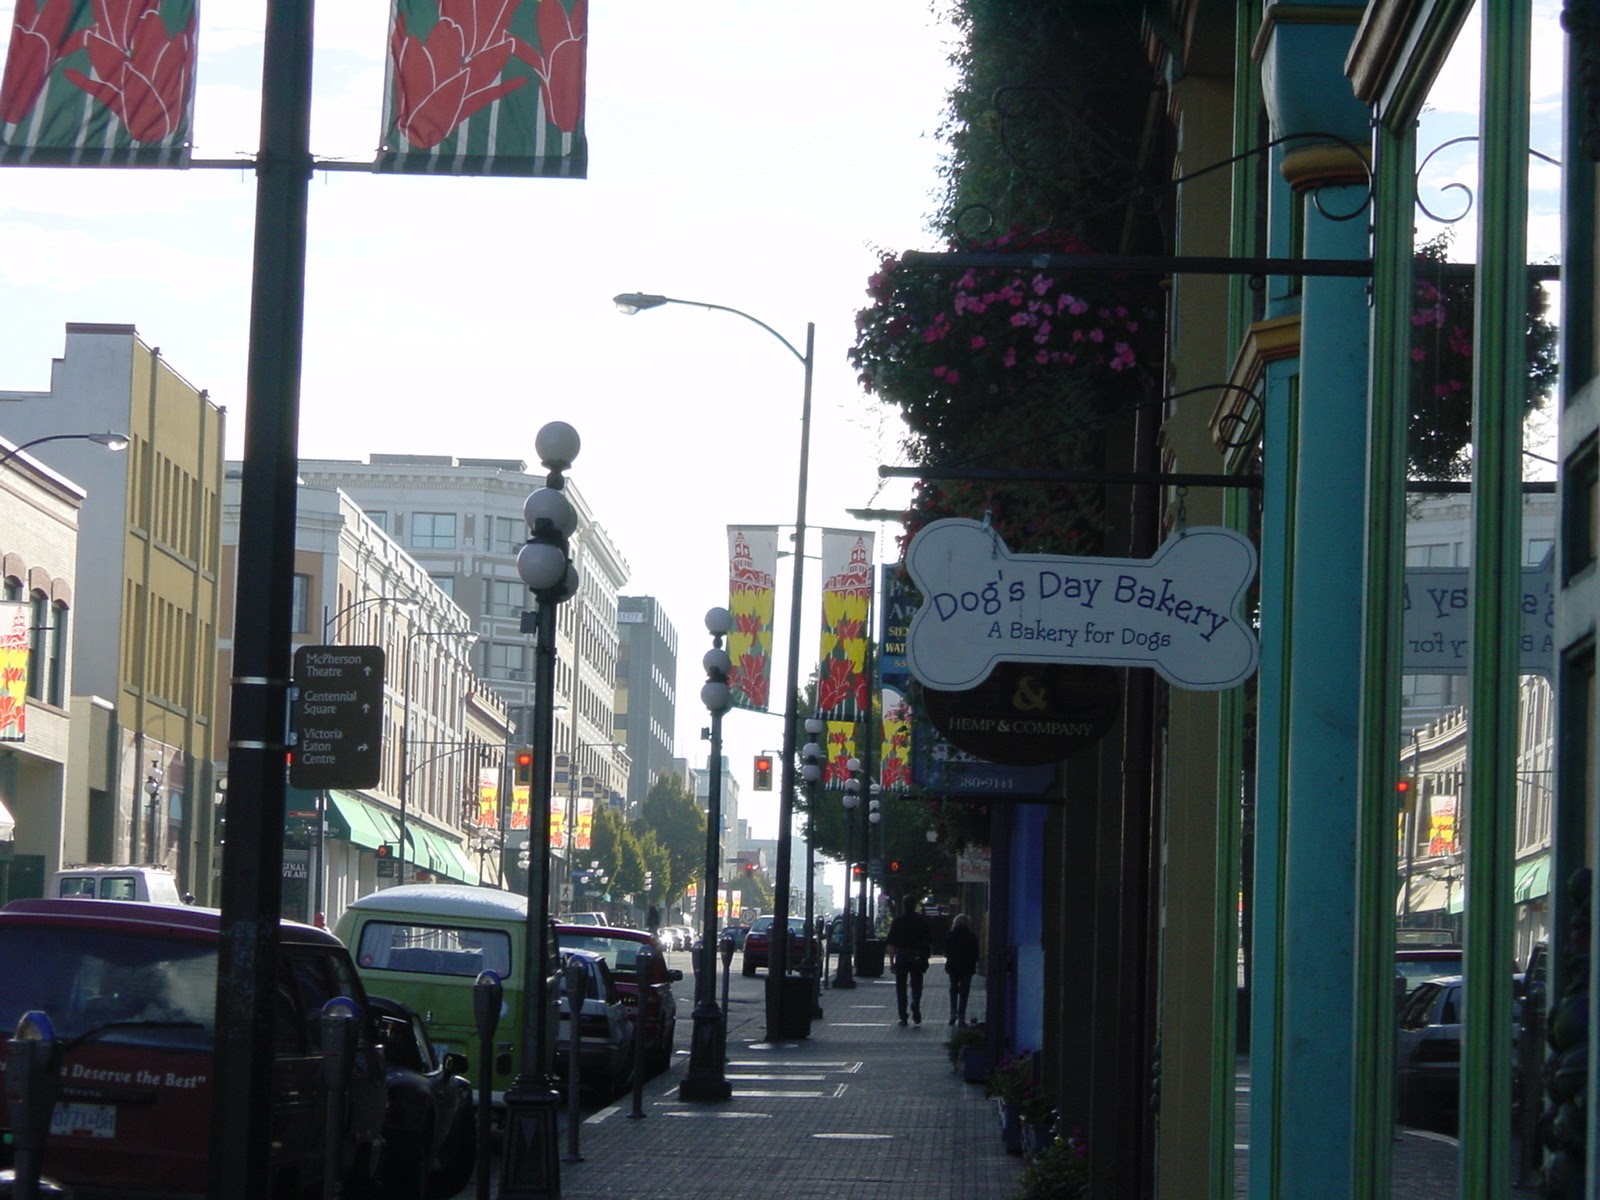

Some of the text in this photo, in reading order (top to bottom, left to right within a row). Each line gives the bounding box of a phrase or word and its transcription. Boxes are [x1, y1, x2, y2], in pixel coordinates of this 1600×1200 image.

[933, 570, 1229, 642] Dog's Day Bakery
[988, 619, 1172, 652] A Bakery for Dogs
[306, 653, 362, 665] McPherson
[307, 665, 343, 677] Theatre
[304, 690, 357, 701] Centennial
[304, 703, 336, 715] Square
[949, 717, 1093, 736] HEMP & COMPANY
[304, 728, 343, 739] Victoria
[303, 740, 331, 751] Eaton
[302, 753, 336, 764] Centre
[72, 1063, 132, 1083] Deserve
[136, 1071, 161, 1085] the
